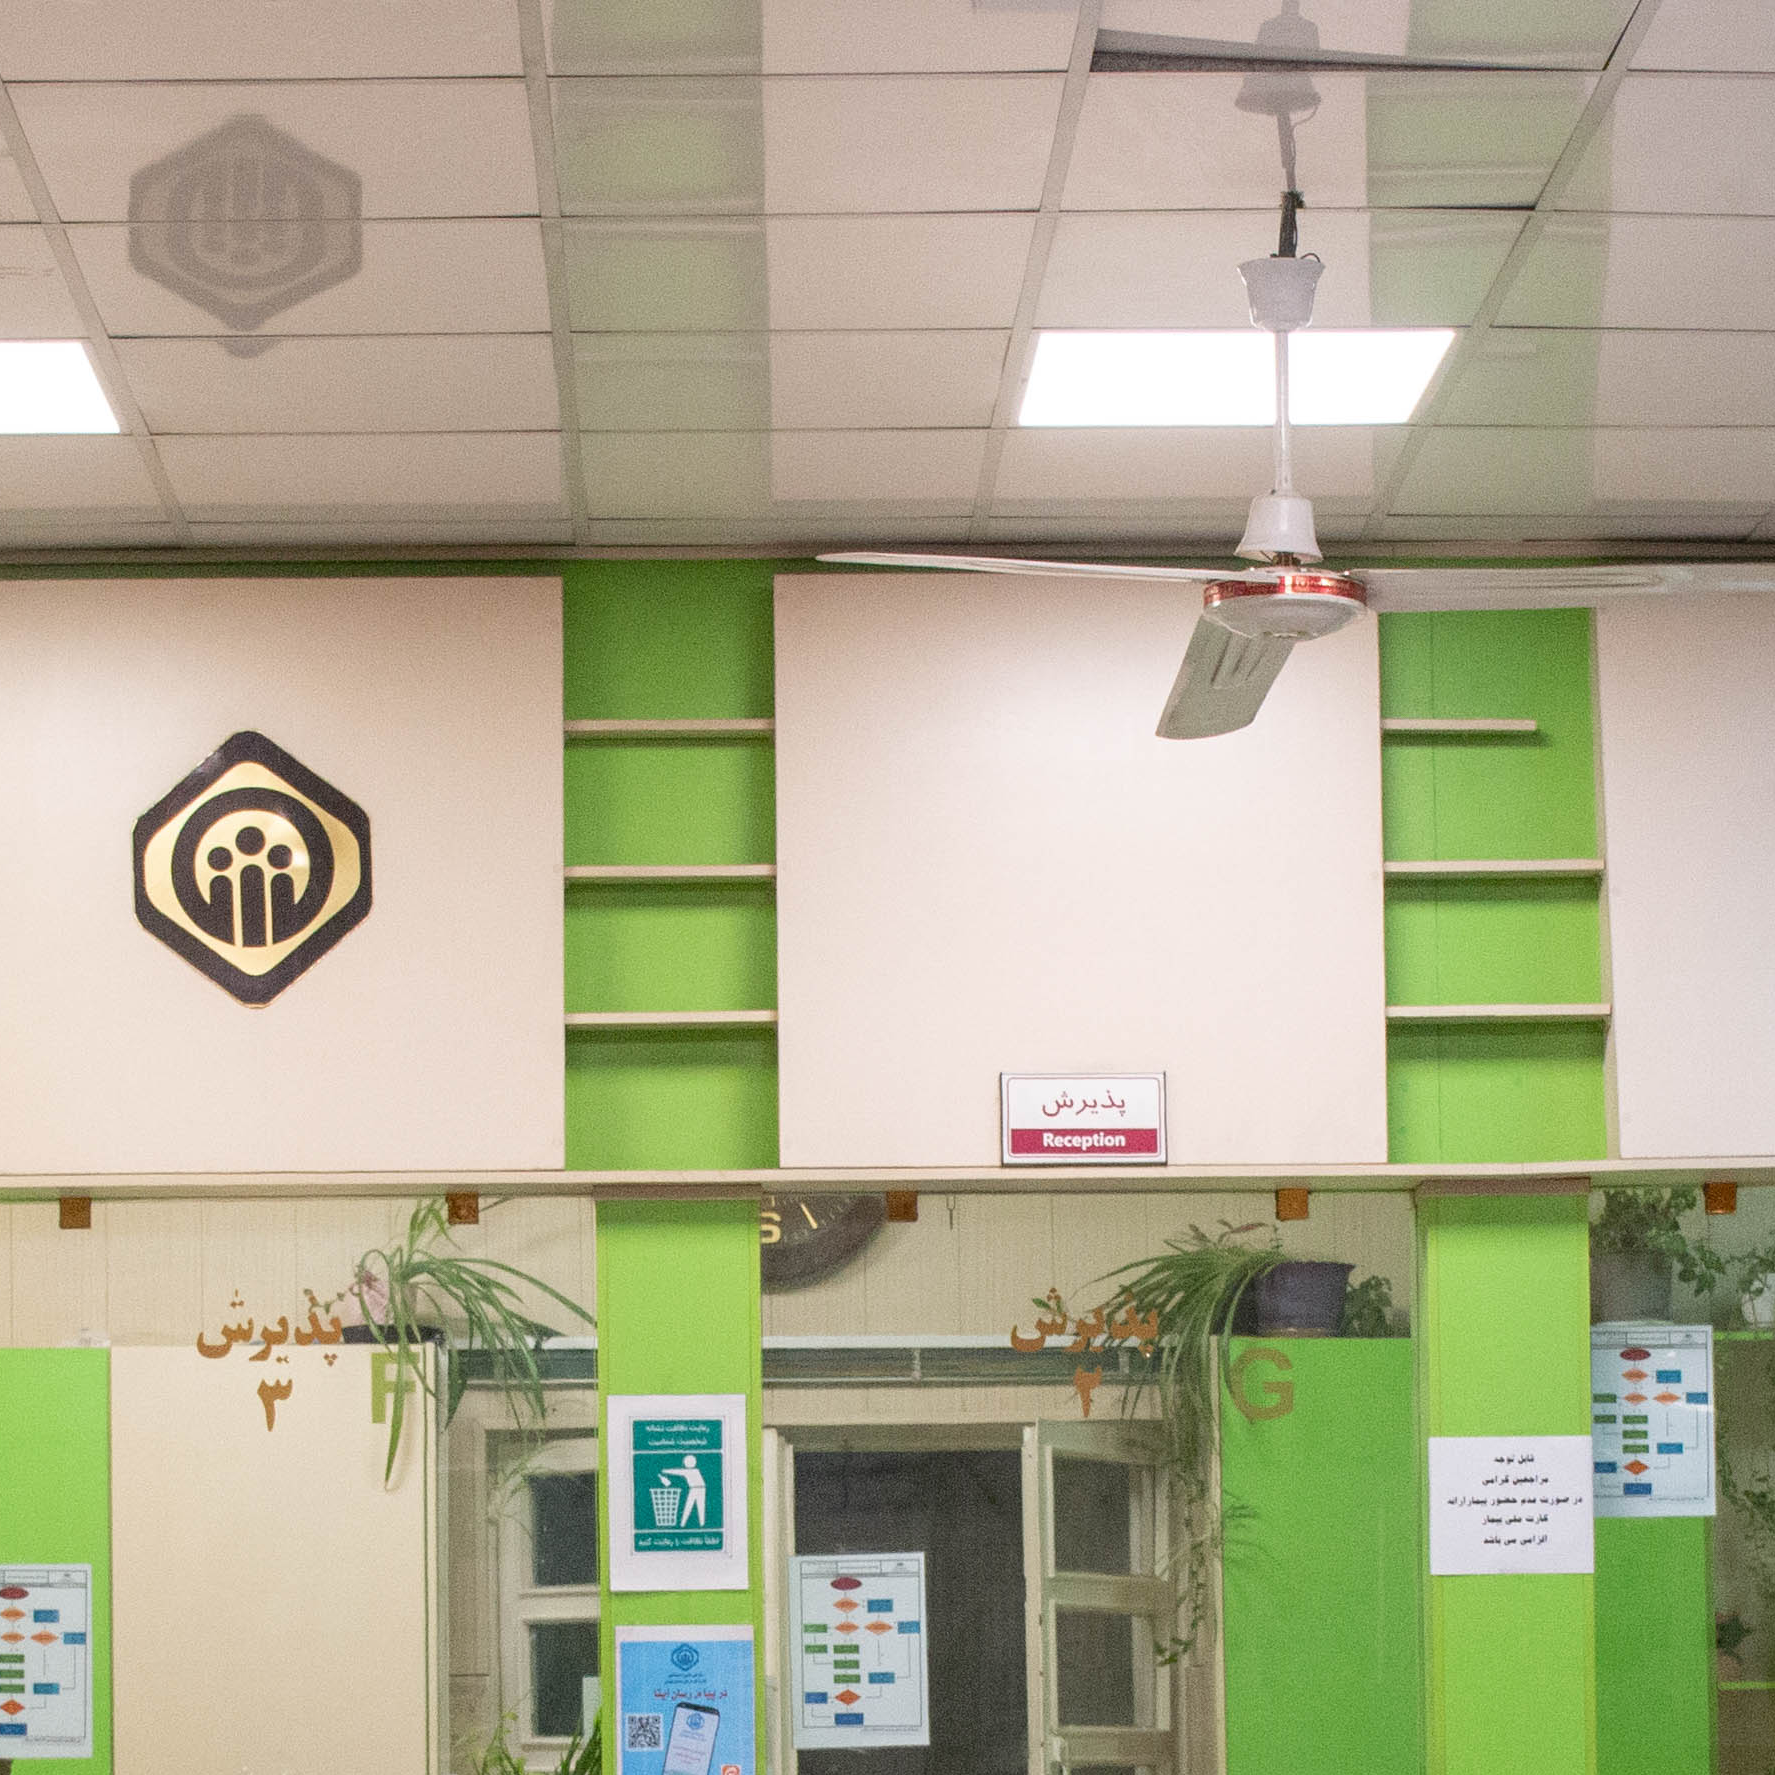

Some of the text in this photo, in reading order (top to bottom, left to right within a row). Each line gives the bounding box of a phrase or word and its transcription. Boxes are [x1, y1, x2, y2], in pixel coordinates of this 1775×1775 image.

[1042, 1090, 1125, 1118] پذیرش
[1042, 1132, 1126, 1151] Reception
[197, 1288, 343, 1367] پذیرش
[1010, 1287, 1158, 1358] پذیرش
[257, 1378, 293, 1432] ۳
[1230, 1347, 1294, 1422] G
